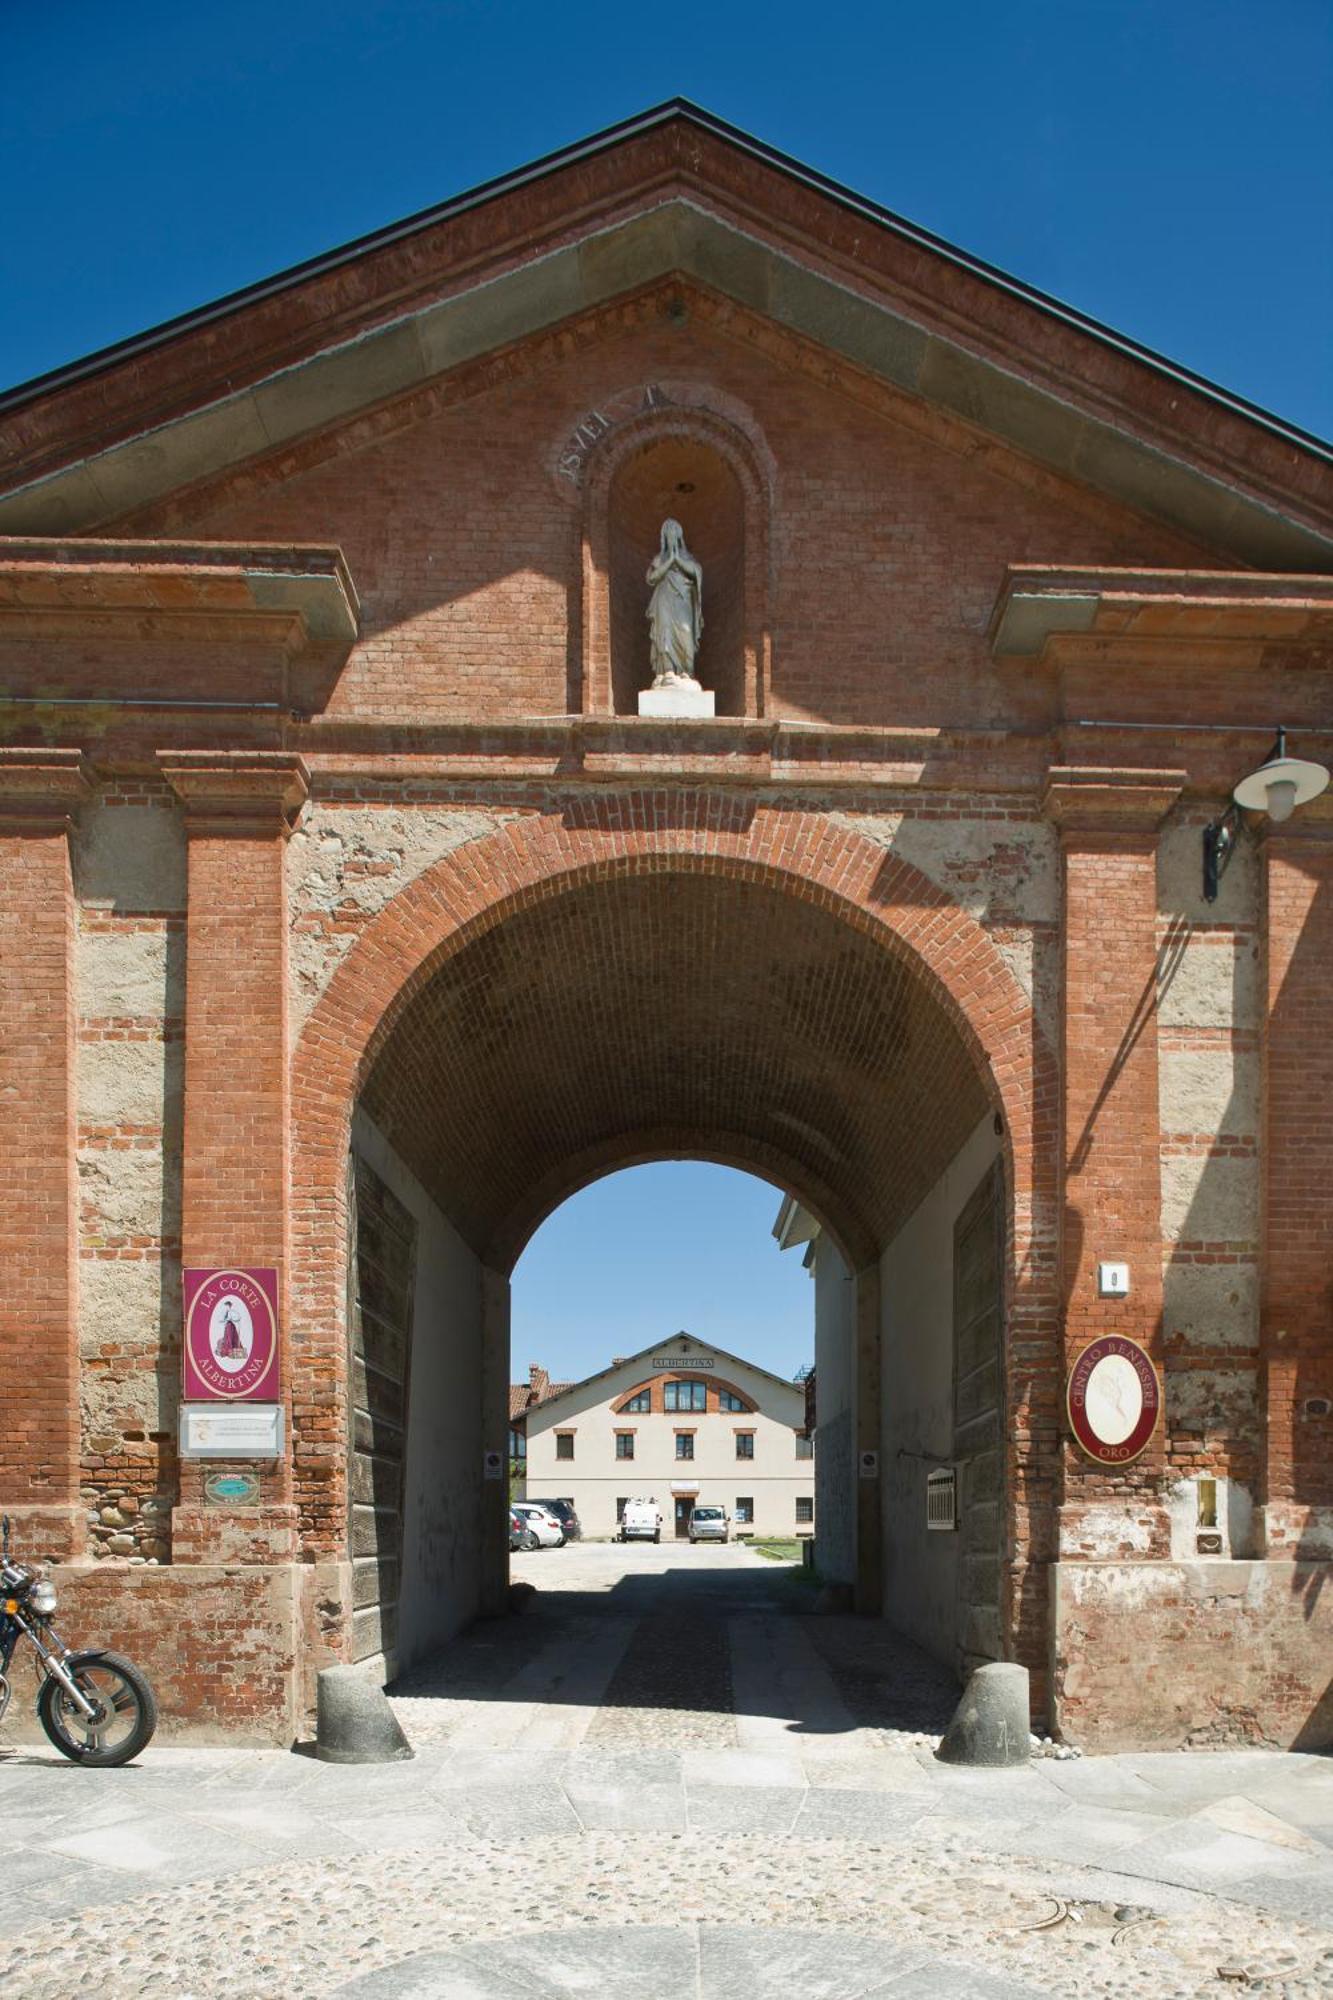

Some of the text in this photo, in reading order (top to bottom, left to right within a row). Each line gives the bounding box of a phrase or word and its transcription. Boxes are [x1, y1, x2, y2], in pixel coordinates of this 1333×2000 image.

[201, 1279, 261, 1309] LA CORTE
[199, 1359, 263, 1388] ALBERTINA
[1073, 1349, 1101, 1407] CENTRO
[1098, 1447, 1130, 1458] ORO
